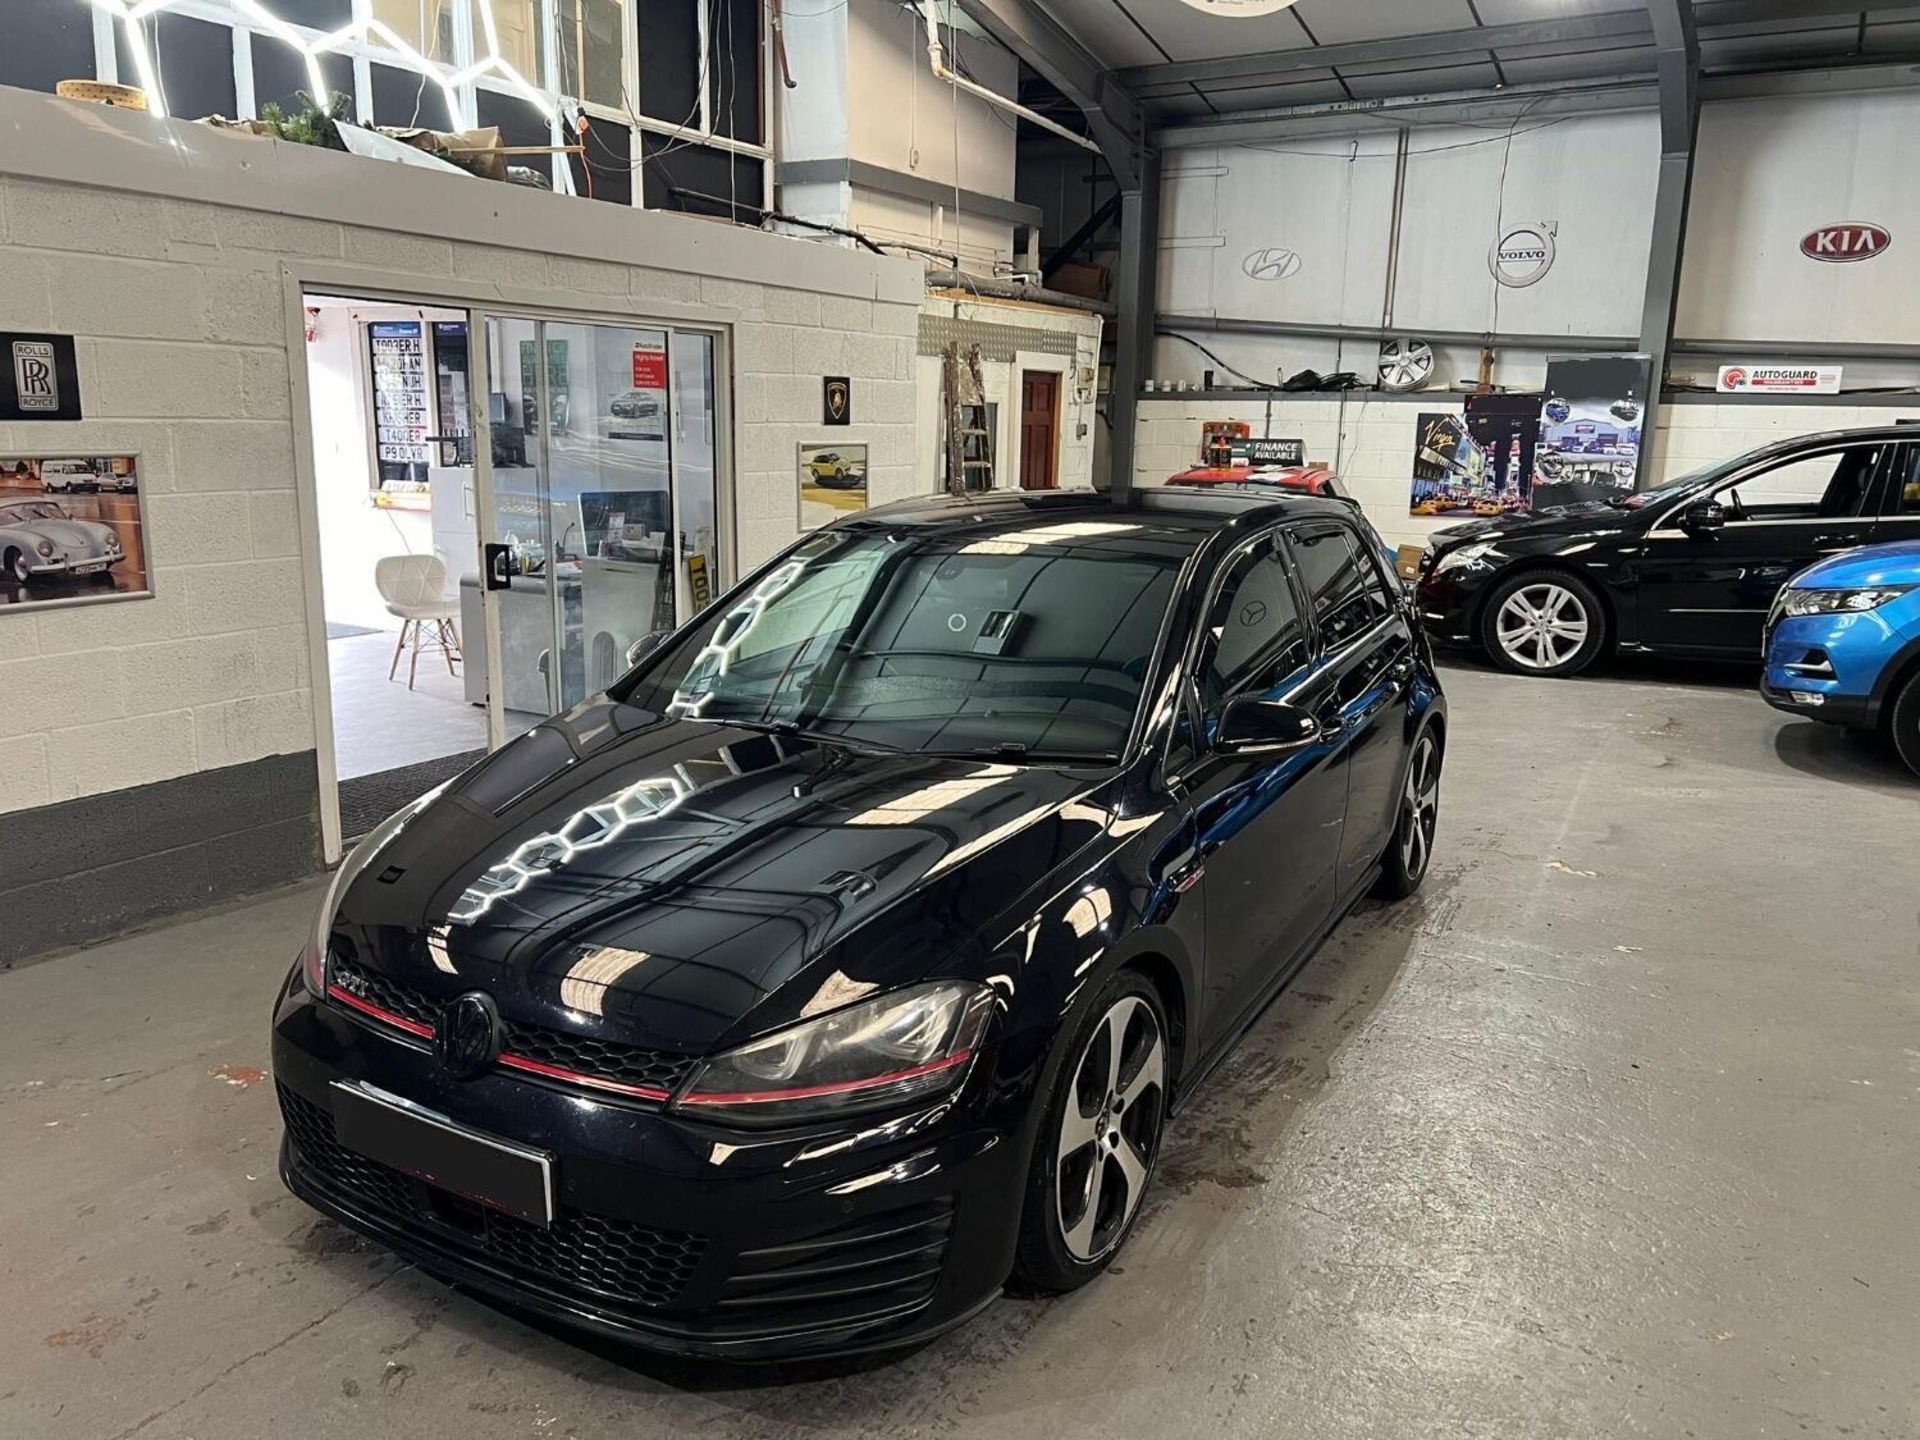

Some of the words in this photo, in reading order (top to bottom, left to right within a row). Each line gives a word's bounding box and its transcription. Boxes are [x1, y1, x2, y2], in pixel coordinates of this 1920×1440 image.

[1816, 229, 1876, 252] KIA
[1500, 250, 1545, 259] VOLVO
[17, 346, 50, 355] ROLLS
[1753, 370, 1817, 379] AUTOGUARD
[23, 398, 54, 407] ROYCE
[1254, 442, 1298, 452] FINANCE
[1254, 451, 1296, 460] AVAILABLE
